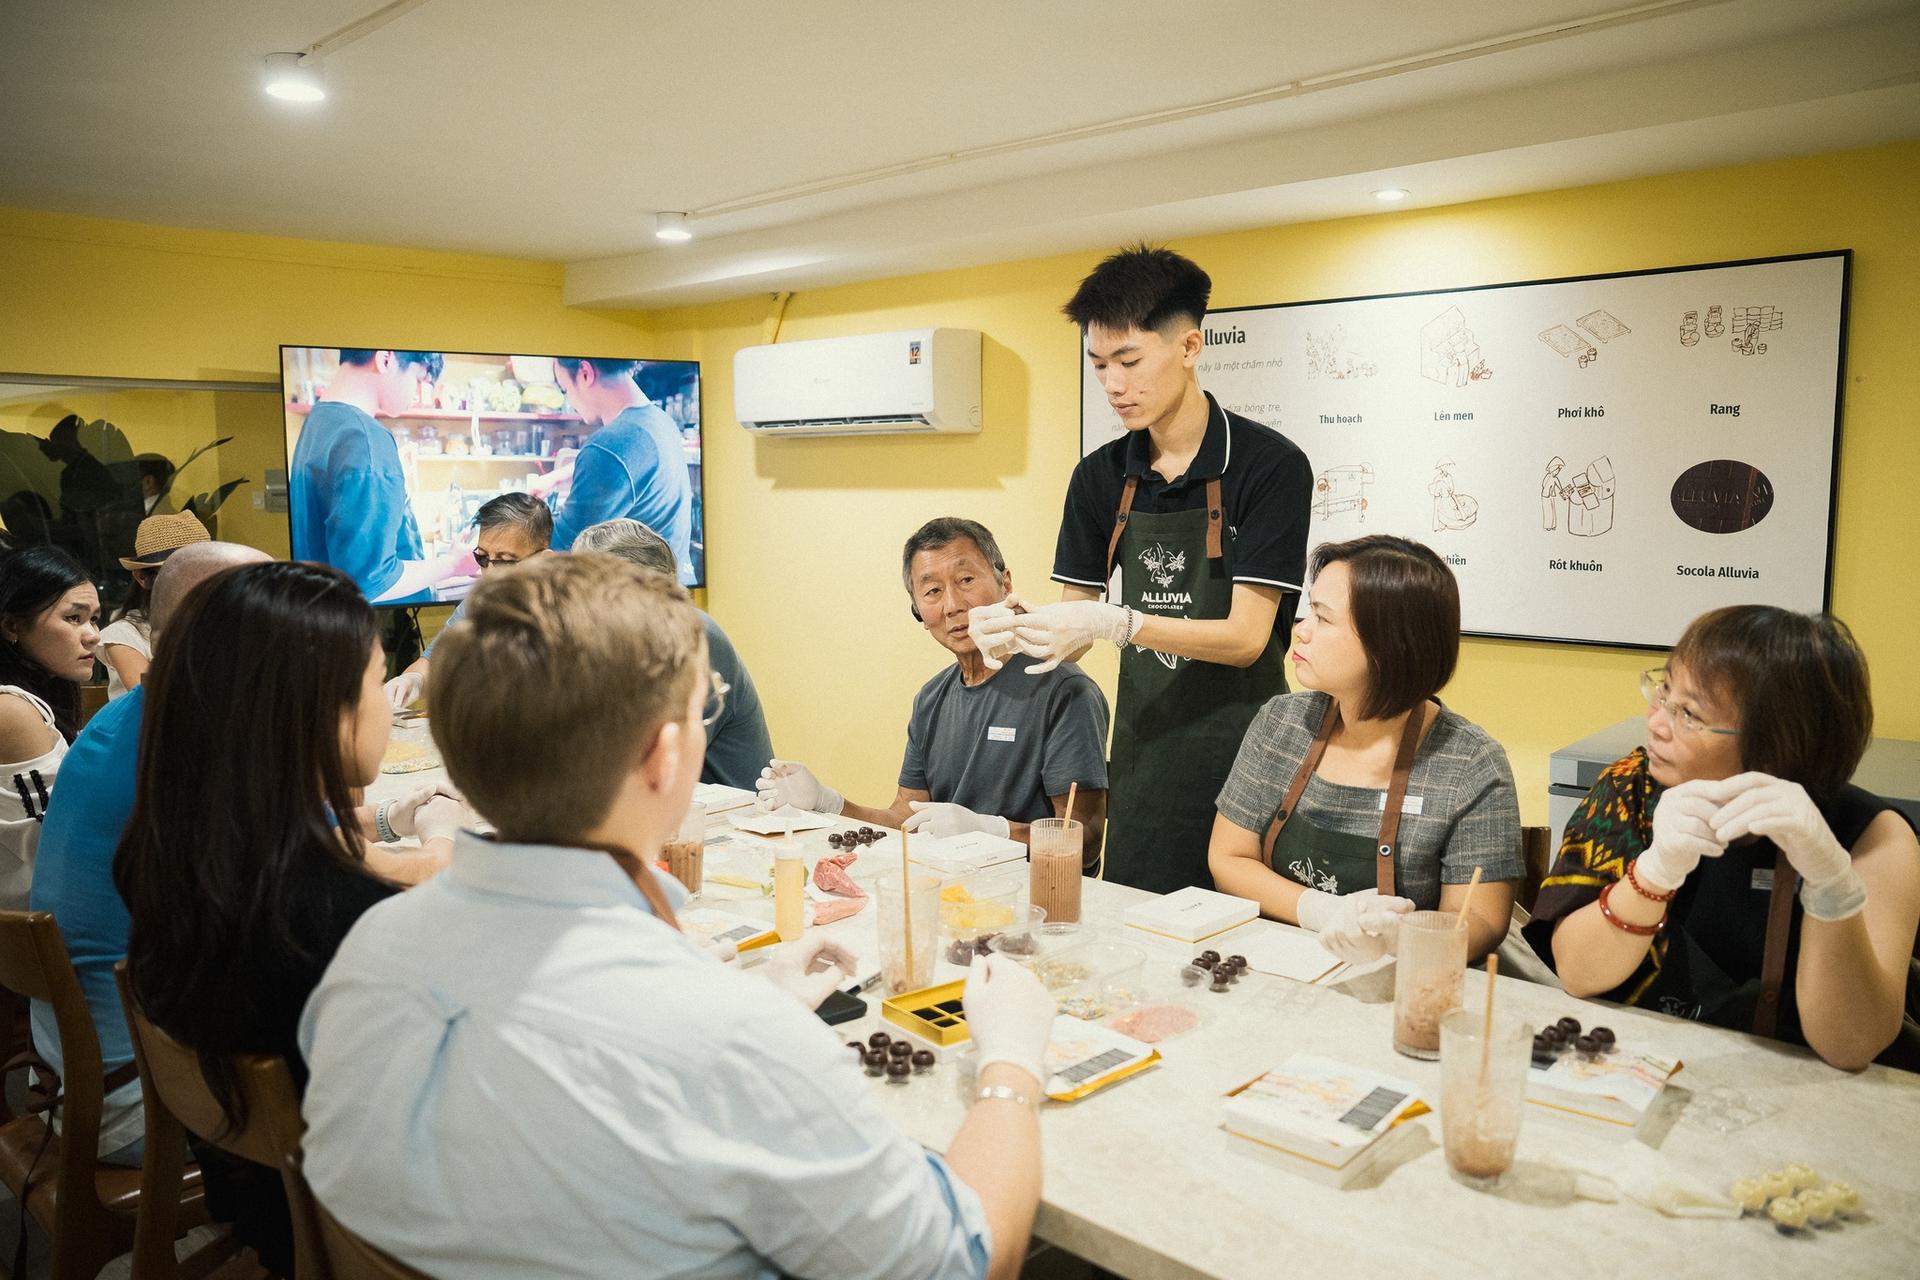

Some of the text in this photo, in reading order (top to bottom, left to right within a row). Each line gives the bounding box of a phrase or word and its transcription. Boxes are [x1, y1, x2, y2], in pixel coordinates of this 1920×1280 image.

[1204, 326, 1246, 346] lluvia
[1434, 410, 1474, 421] Lên men
[1558, 405, 1605, 418] Phơi khô
[1710, 403, 1741, 417] Rang
[1319, 413, 1363, 425] Thu hoạch
[1549, 558, 1603, 572] Rót khuôn
[1676, 565, 1760, 579] Socola Alluvia
[1141, 591, 1193, 604] ALLUVIA
